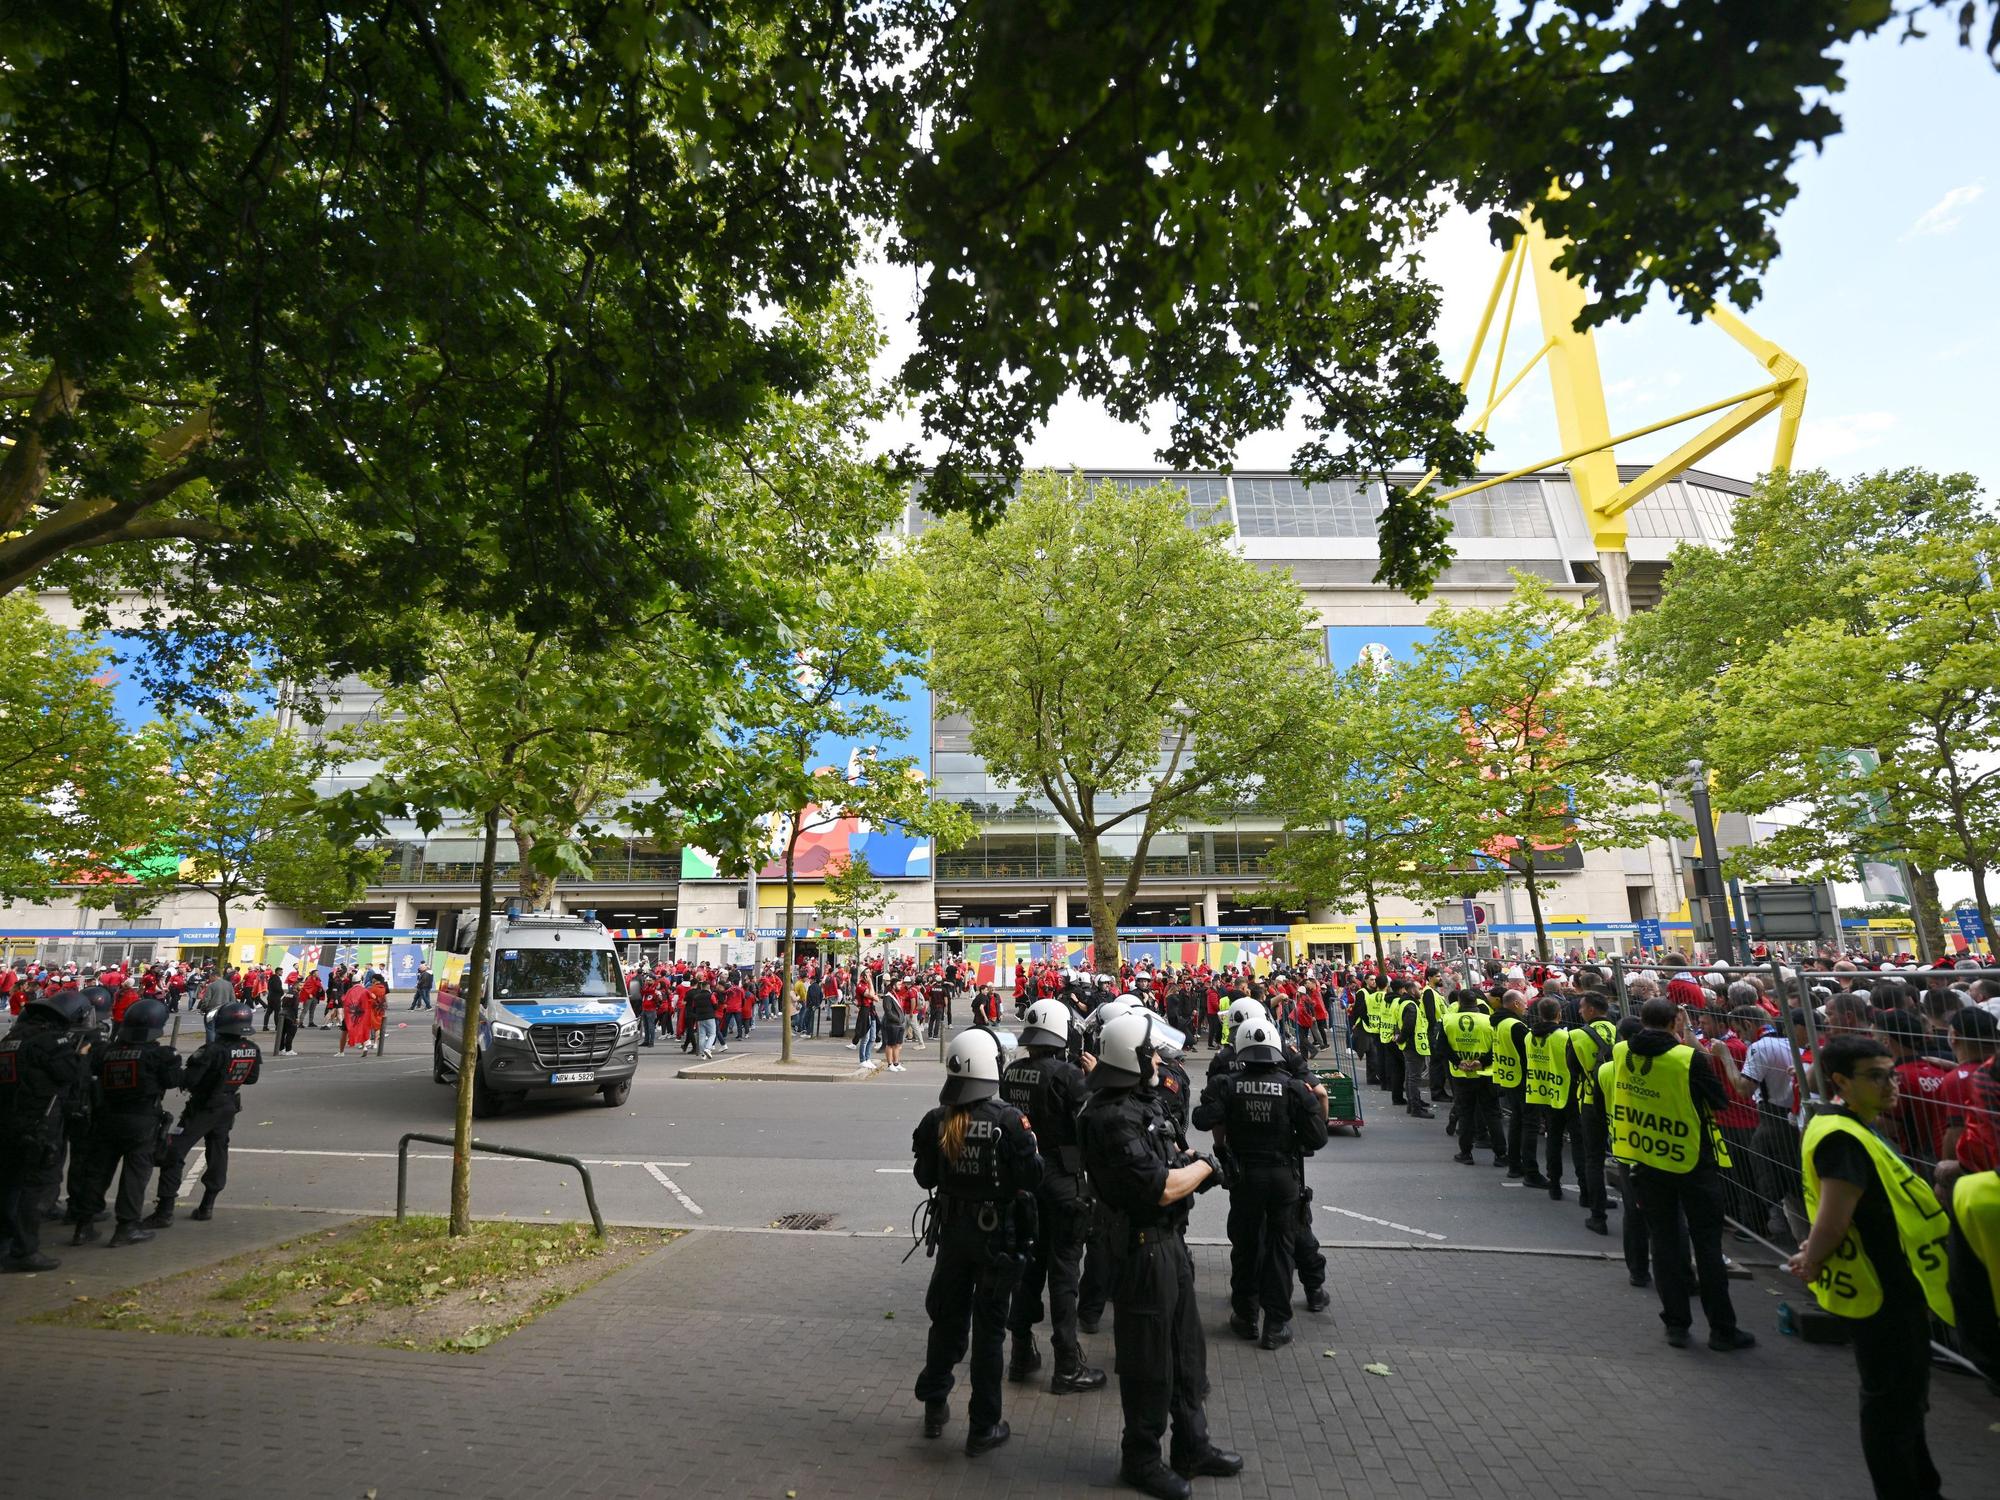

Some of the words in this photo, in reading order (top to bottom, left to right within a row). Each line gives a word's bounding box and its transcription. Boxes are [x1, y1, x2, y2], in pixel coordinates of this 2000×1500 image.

[1245, 1030, 1252, 1041] 4
[1267, 1030, 1272, 1041] 1
[964, 1058, 971, 1073] 1
[1004, 1068, 1041, 1084] POLIZEI
[1009, 1088, 1031, 1103] NRW
[1236, 1081, 1283, 1097] POLIZEI
[1616, 1081, 1661, 1099] EURO2024
[1245, 1100, 1272, 1112] NRW
[1250, 1111, 1271, 1123] 1411
